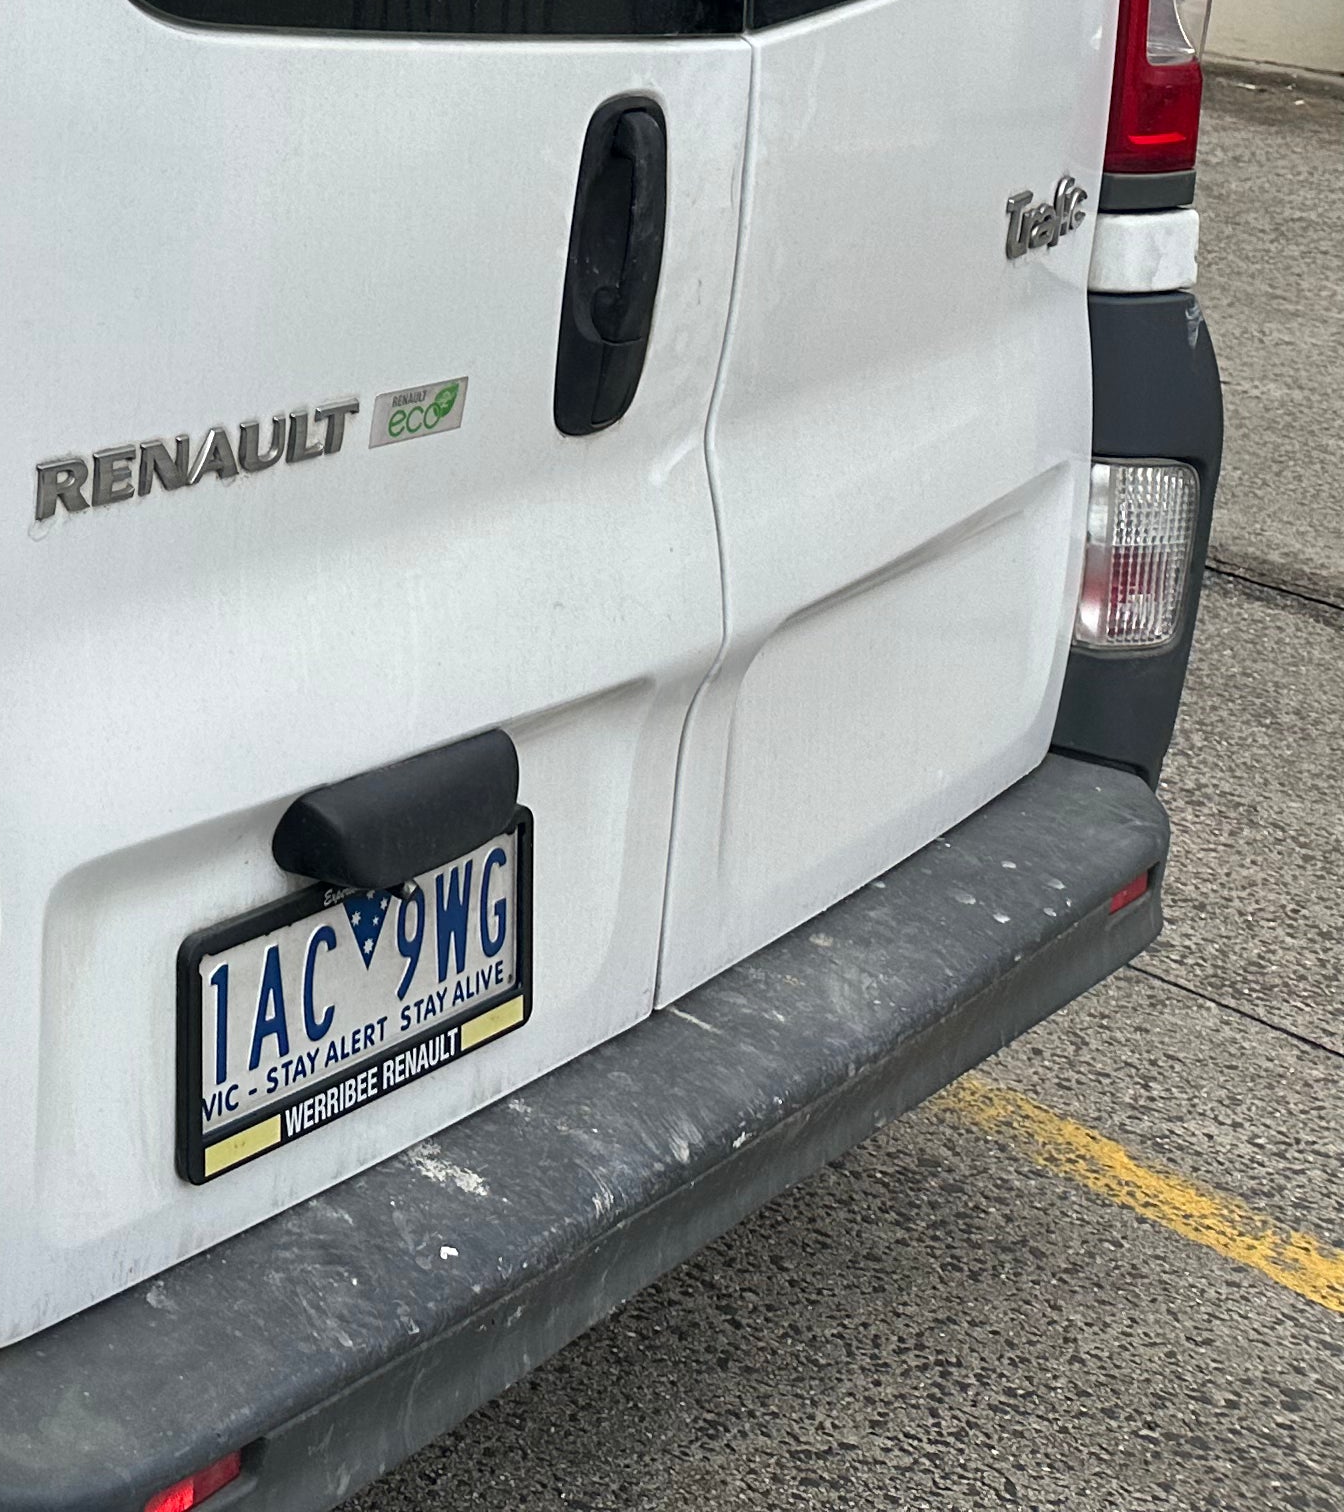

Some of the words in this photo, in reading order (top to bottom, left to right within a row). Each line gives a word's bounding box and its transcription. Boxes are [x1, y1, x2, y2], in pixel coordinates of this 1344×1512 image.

[1004, 173, 1088, 262] Trafic
[392, 390, 428, 408] RENAULT
[34, 396, 360, 522] RENAULT
[210, 925, 337, 1086] 1AC
[397, 847, 508, 1002] 9WG
[201, 1083, 241, 1122] VIC
[266, 1047, 320, 1095] STAY
[325, 1016, 388, 1069] ALERT
[400, 987, 448, 1032] STAY
[453, 960, 505, 1006] ALIVE
[285, 1067, 379, 1138] WERRIBEE
[382, 1027, 459, 1087] RENAULT
